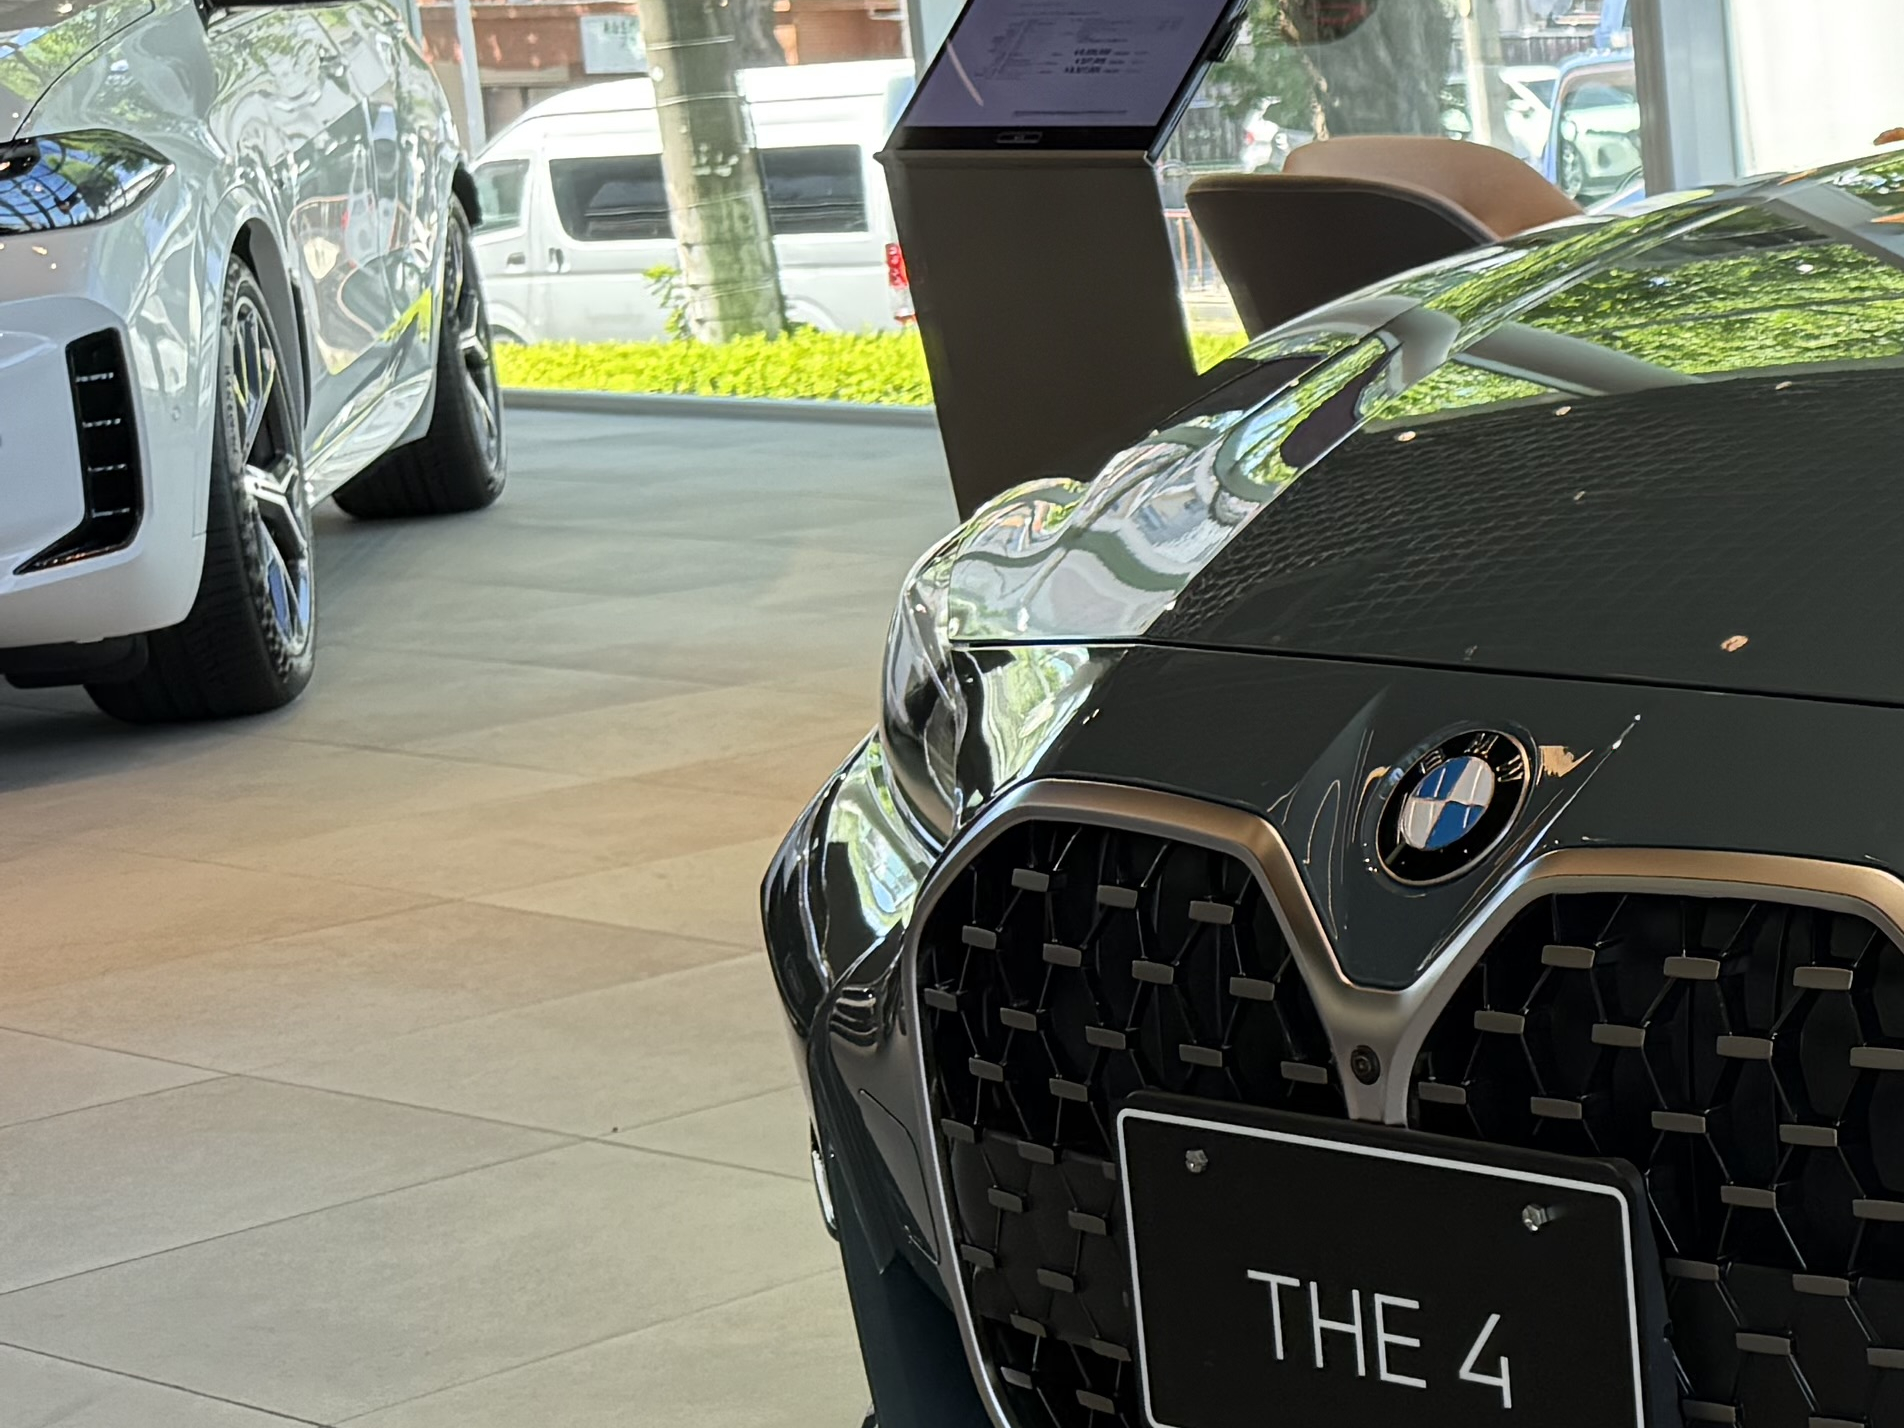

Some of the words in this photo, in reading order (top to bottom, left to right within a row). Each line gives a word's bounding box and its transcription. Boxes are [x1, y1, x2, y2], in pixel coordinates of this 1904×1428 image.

[1419, 732, 1524, 783] BMW
[1246, 1268, 1427, 1389] THE
[1458, 1312, 1514, 1410] 4
